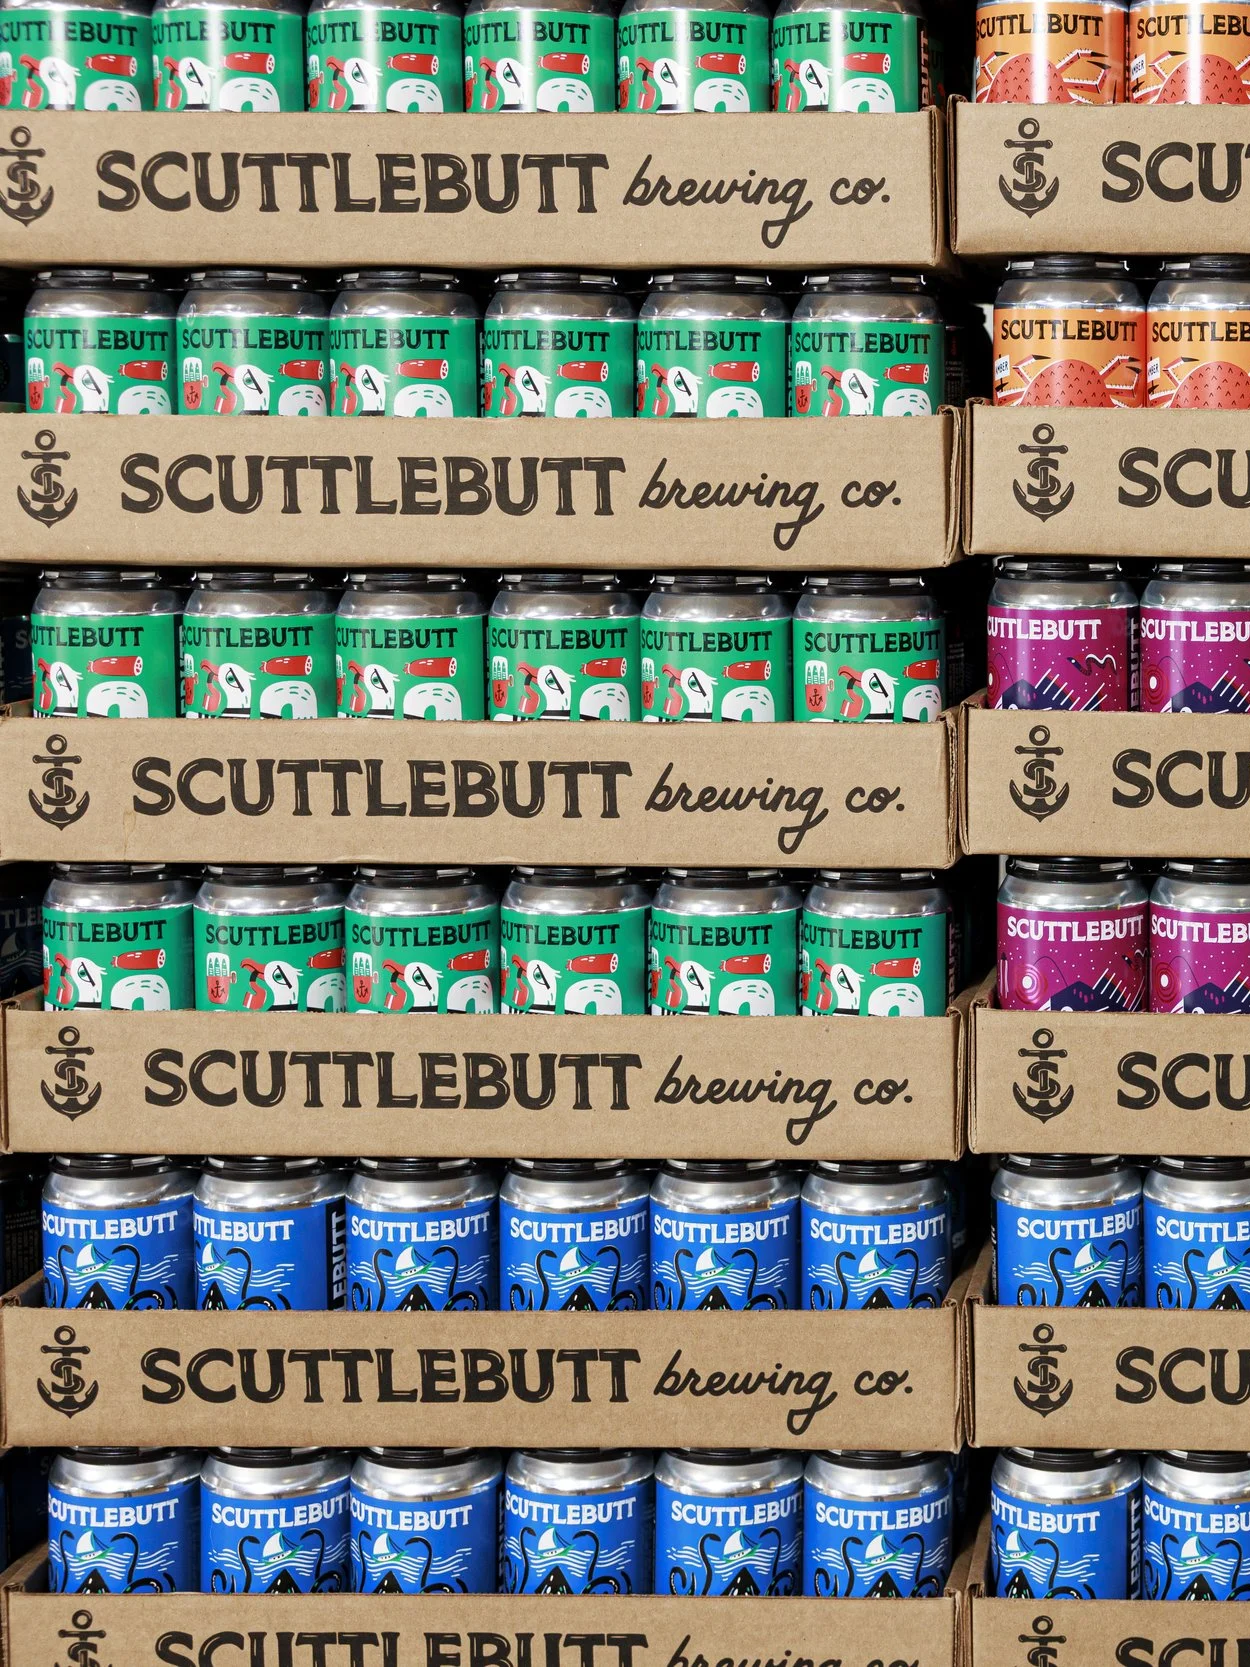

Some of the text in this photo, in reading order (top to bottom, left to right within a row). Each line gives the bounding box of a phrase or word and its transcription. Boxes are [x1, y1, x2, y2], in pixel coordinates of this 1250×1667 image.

[97, 151, 891, 249] SCUTTLEBUTT brewing co.
[27, 329, 169, 352] SCUTTLEBUTT
[182, 329, 326, 351] SCUTTLEBUTT
[794, 333, 932, 354] SCUTTLEBUTT
[1000, 320, 1138, 342] SCUTTLEBUTT
[119, 452, 902, 551] SCUTTLEBUTT brewing co.
[491, 630, 628, 650] SCUTTLEBUTT
[641, 632, 773, 653] SCUTTLEBUTT
[804, 631, 941, 653] SCUTTLEBUTT
[131, 757, 907, 855] SCUTTLEBUTT brewing co.
[352, 920, 494, 947] SCUTTLEBUTT
[1007, 915, 1145, 942] SCUTTLEBUTT
[143, 1048, 914, 1145] SCUTTLEBUTT brewing co.
[351, 1212, 490, 1242] SCUTTLEBUTT
[510, 1211, 649, 1243] SCUTTLEBUTT
[654, 1215, 791, 1244] SCUTTLEBUTT
[810, 1214, 947, 1244] SCUTTLEBUTT
[139, 1347, 914, 1435] SCUTTLEBUTT brewing co.
[505, 1495, 637, 1525] SCUTTLEBUTT
[815, 1496, 950, 1531] SCUTTLEBUTT
